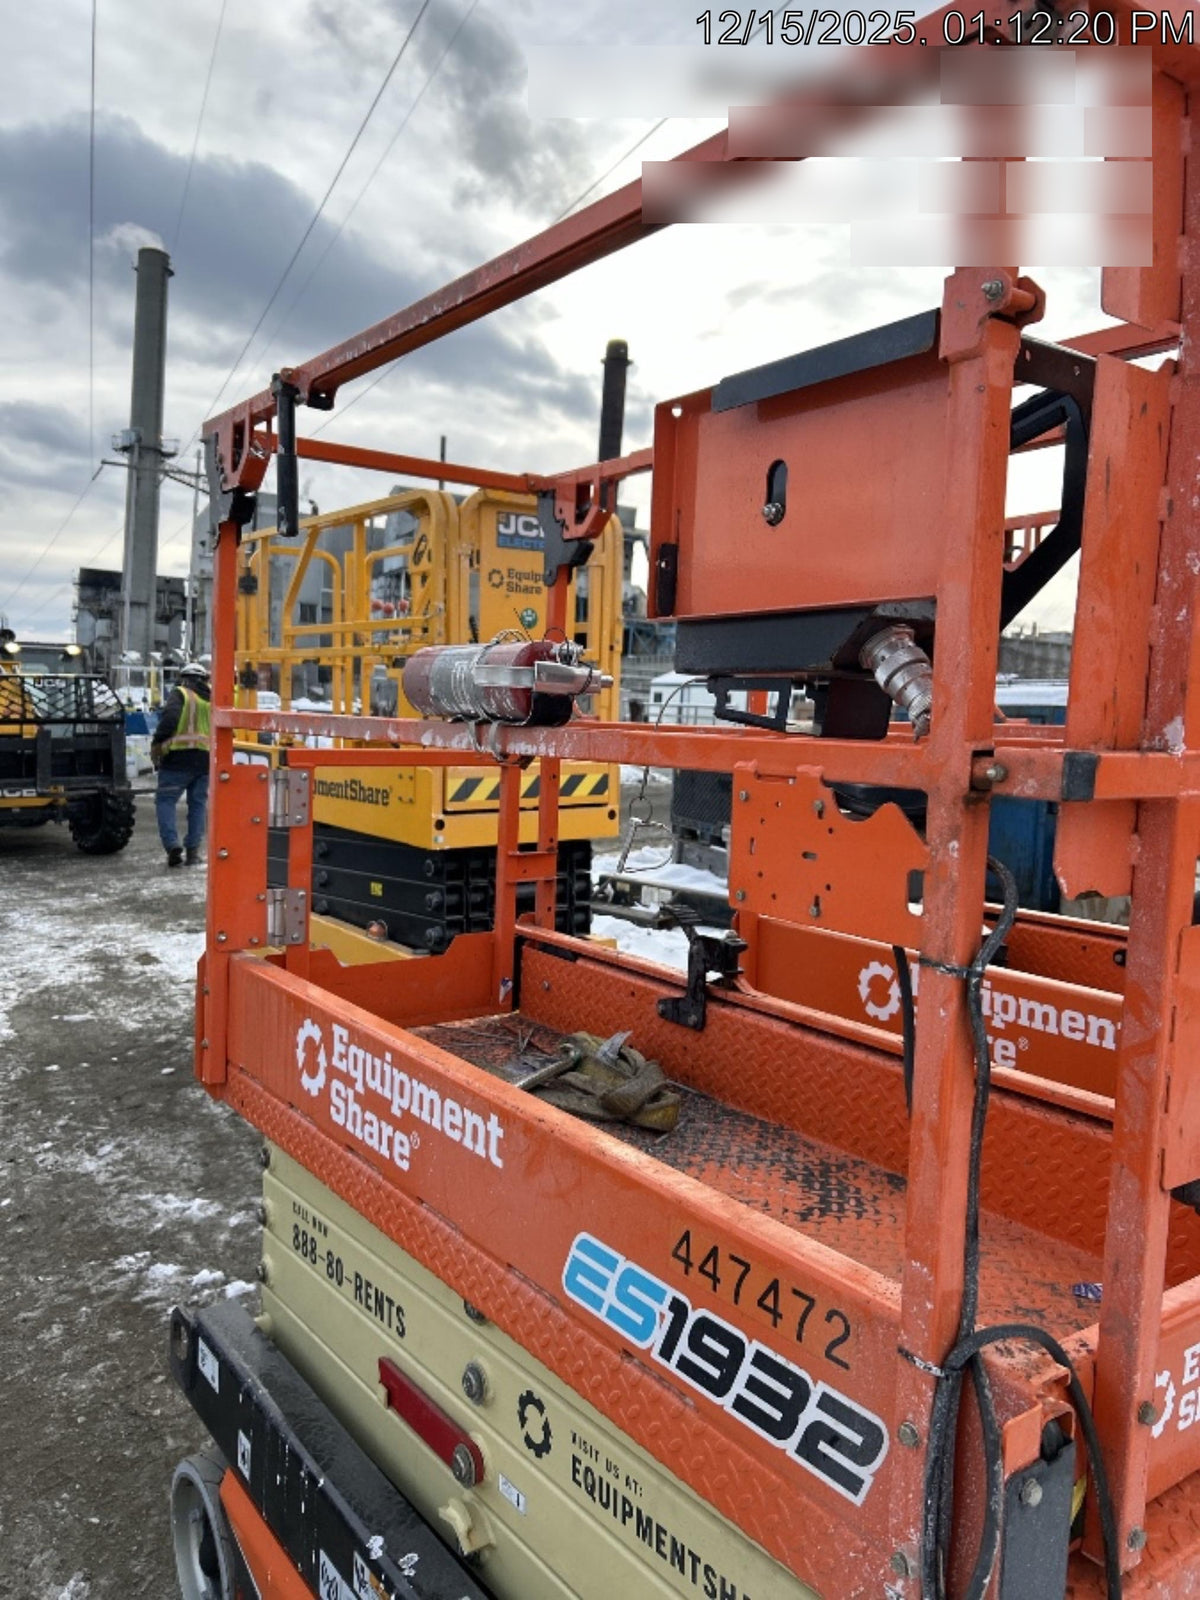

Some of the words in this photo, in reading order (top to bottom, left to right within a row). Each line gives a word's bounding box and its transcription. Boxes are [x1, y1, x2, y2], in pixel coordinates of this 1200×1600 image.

[498, 514, 545, 538] JC
[506, 580, 543, 595] Share
[331, 1023, 504, 1168] Equipment
[292, 1222, 406, 1338] 888-80-RENTS
[671, 1229, 851, 1371] 447472
[563, 1233, 889, 1505] ES1932
[571, 1430, 599, 1463] VISIT
[605, 1457, 620, 1480] US
[625, 1475, 643, 1497] AT:
[571, 1453, 752, 1600] EQUIPMENTSH
